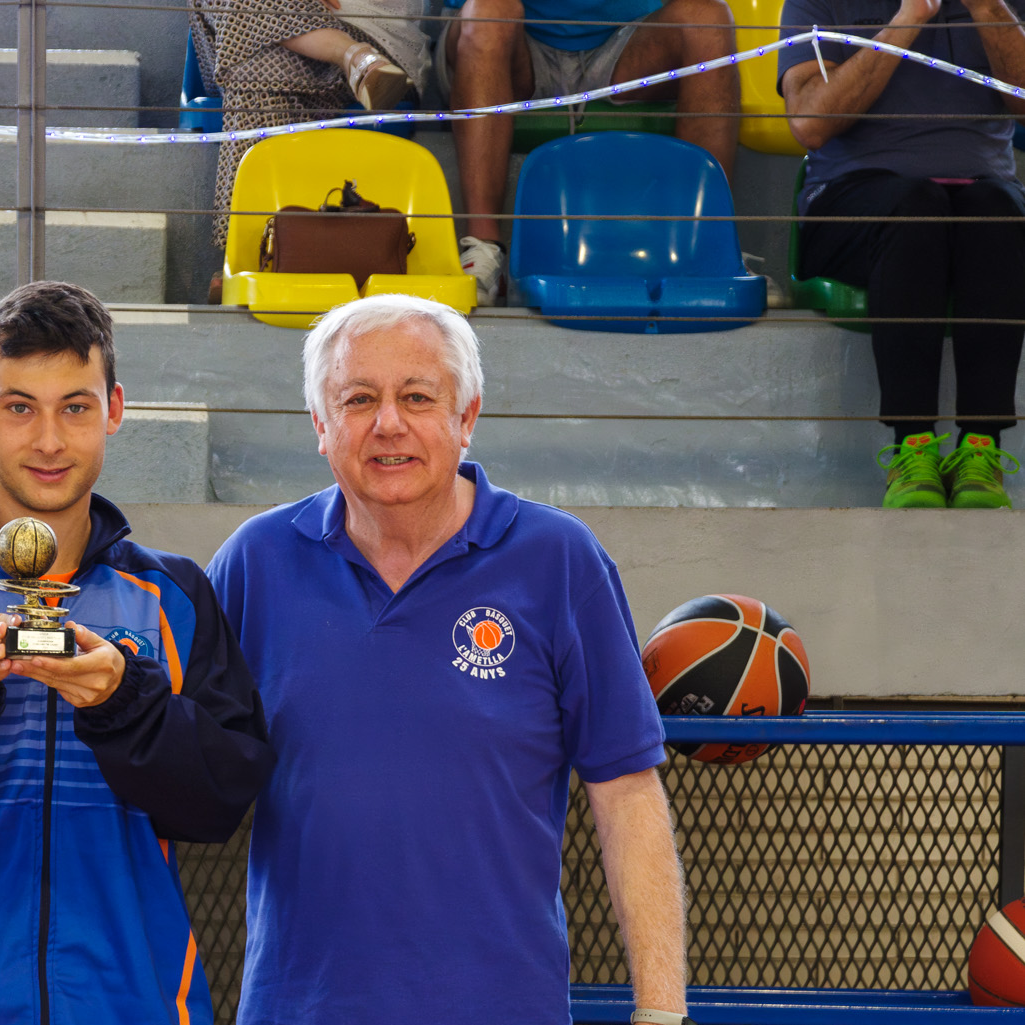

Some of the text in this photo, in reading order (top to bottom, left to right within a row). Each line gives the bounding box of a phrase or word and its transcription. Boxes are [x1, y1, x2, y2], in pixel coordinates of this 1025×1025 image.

[458, 609, 513, 636] CLUB BASQUET
[457, 644, 505, 665] L'AMETLLA
[451, 656, 506, 680] 25 ANYS
